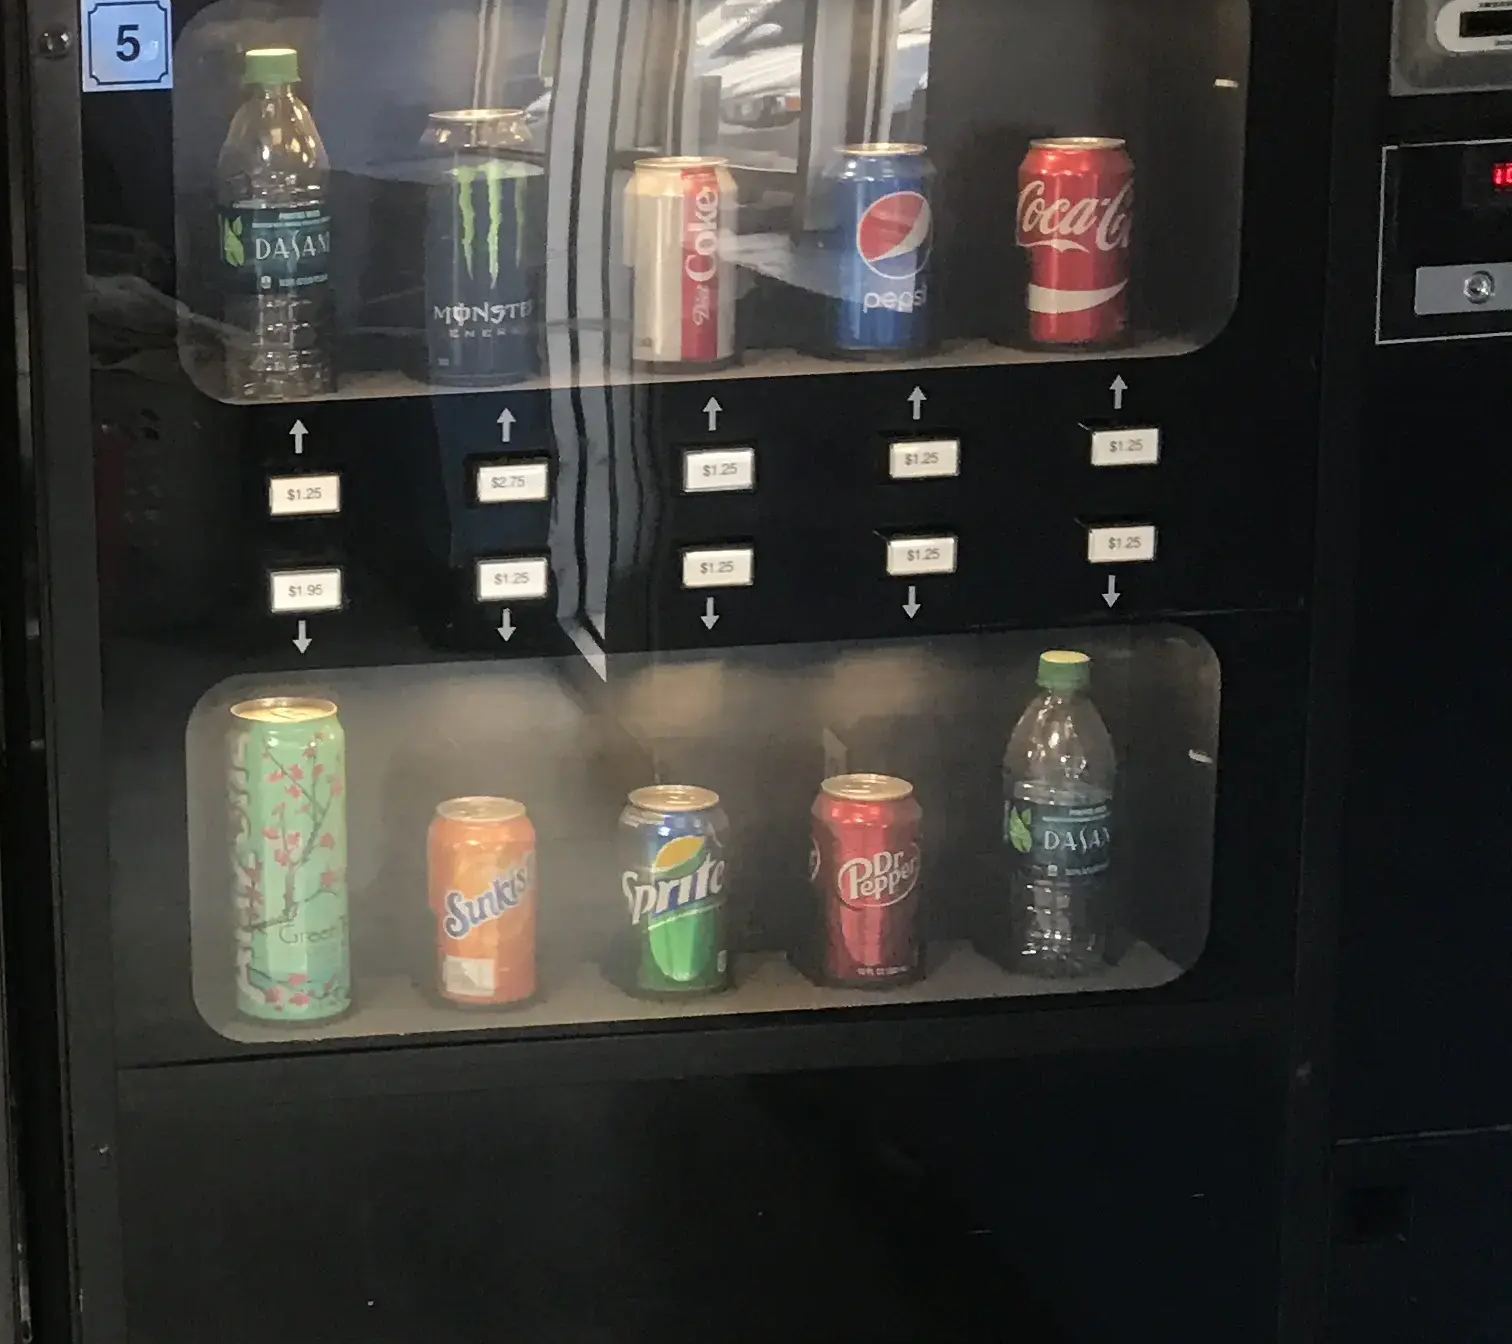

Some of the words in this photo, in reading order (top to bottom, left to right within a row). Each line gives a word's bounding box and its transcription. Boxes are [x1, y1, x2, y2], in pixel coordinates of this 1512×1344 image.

[115, 24, 141, 62] 5
[685, 187, 718, 283] Coke
[863, 287, 928, 316] pepsi
[1109, 438, 1144, 453] $1.25
[905, 451, 939, 466] $1.25
[702, 462, 738, 477] $1.25
[491, 475, 526, 490] $2.75
[286, 486, 322, 501] $1.25
[1108, 536, 1142, 550] $1.25
[907, 547, 941, 562] $1.25
[699, 560, 734, 575] $1.25
[493, 571, 530, 586] $1.25
[288, 583, 324, 598] $1.95
[873, 851, 904, 878] Dr
[838, 857, 918, 901] Pepper
[621, 851, 727, 927] Sprite
[443, 858, 531, 940] Sunkis
